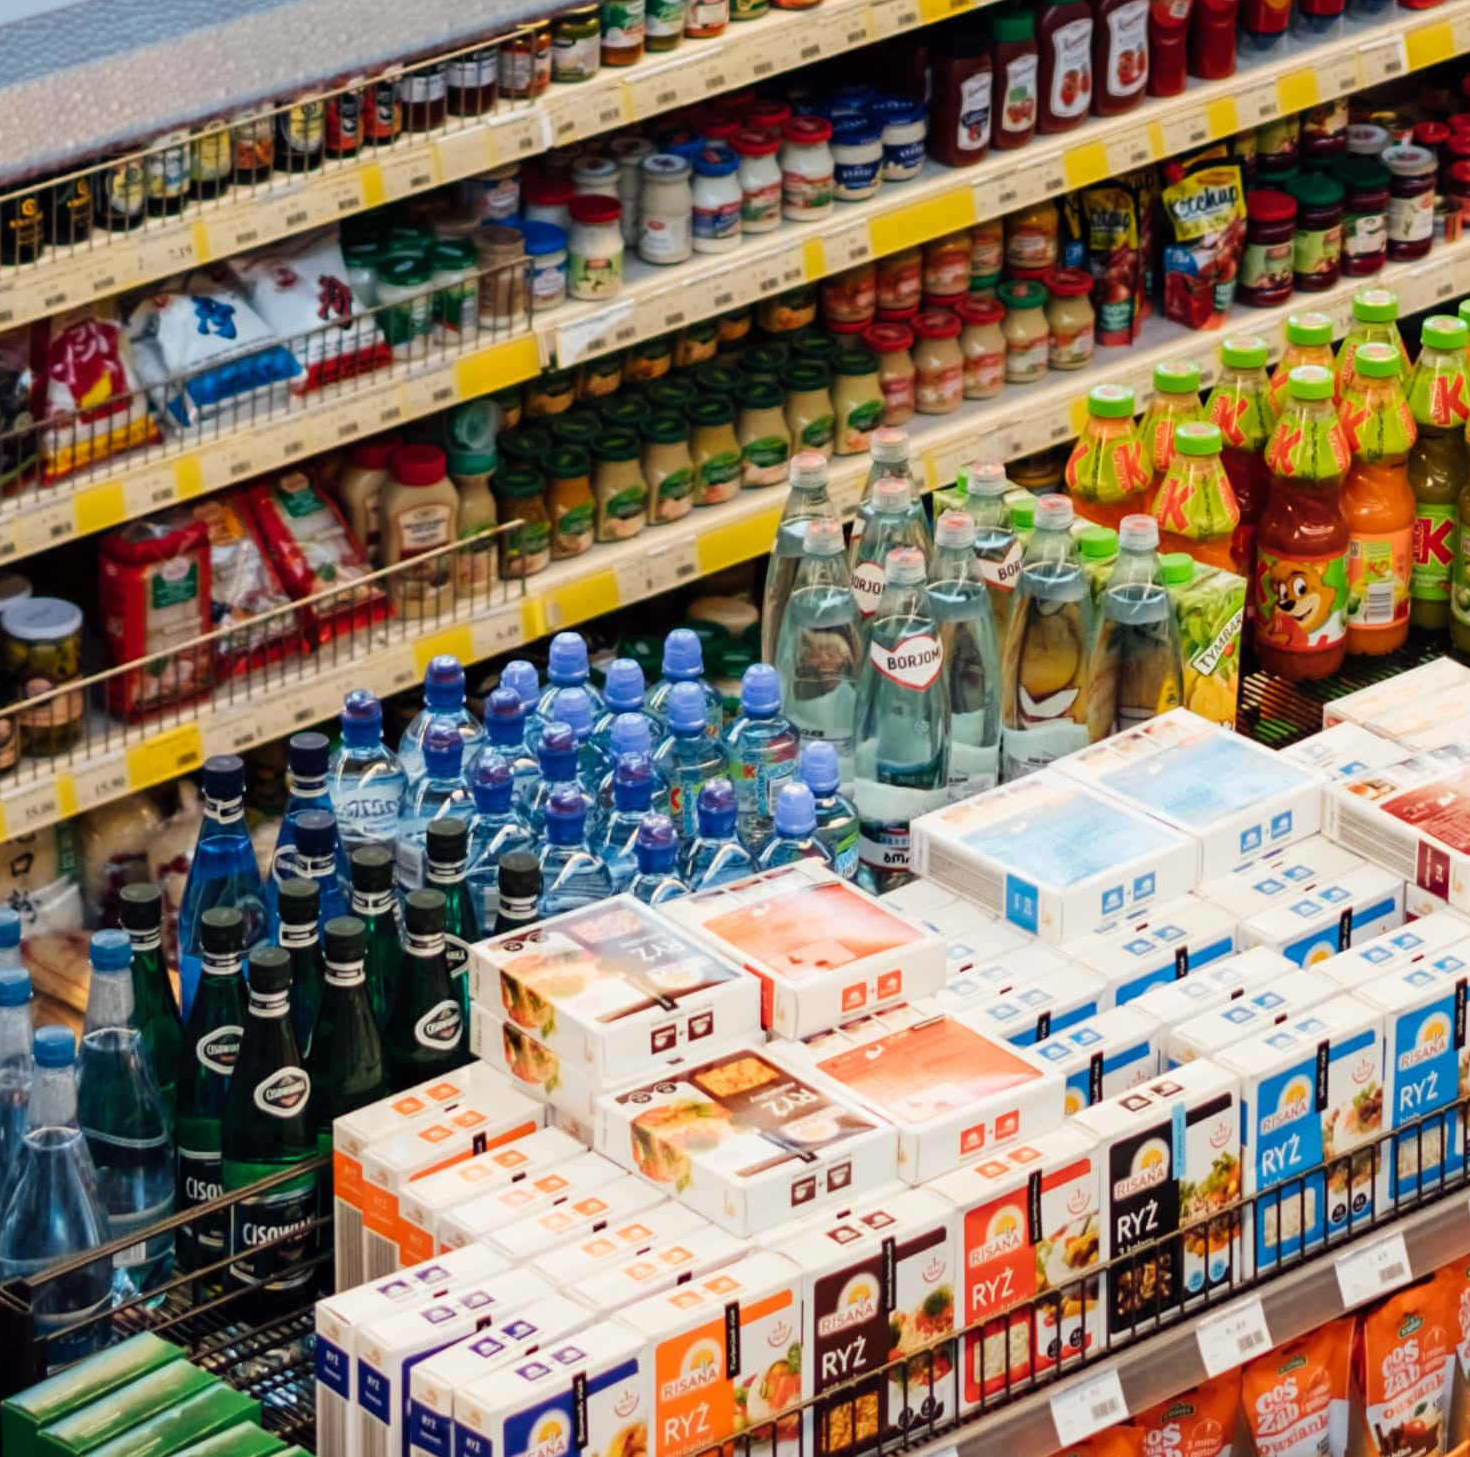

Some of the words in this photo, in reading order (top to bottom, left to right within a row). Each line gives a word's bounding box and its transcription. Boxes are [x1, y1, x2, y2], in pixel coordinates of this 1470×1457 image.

[886, 648, 942, 672] BORJOM
[1399, 1042, 1447, 1071] RISANA
[1399, 1072, 1439, 1112] RYŻ
[1260, 1102, 1311, 1134] RISANA
[1260, 1133, 1302, 1176] RYŻ
[1113, 1168, 1167, 1202] RISANA
[1116, 1197, 1159, 1242] RYŻ
[969, 1232, 1024, 1266] RISANA
[971, 1269, 1015, 1311] RYŻ
[819, 1299, 876, 1334] RISANA
[821, 1334, 868, 1380] RYŻ
[662, 1365, 717, 1400] RISANA
[1383, 1376, 1446, 1420] owsiank
[665, 1401, 710, 1445] RYŻ
[1259, 1414, 1329, 1456] owsiank
